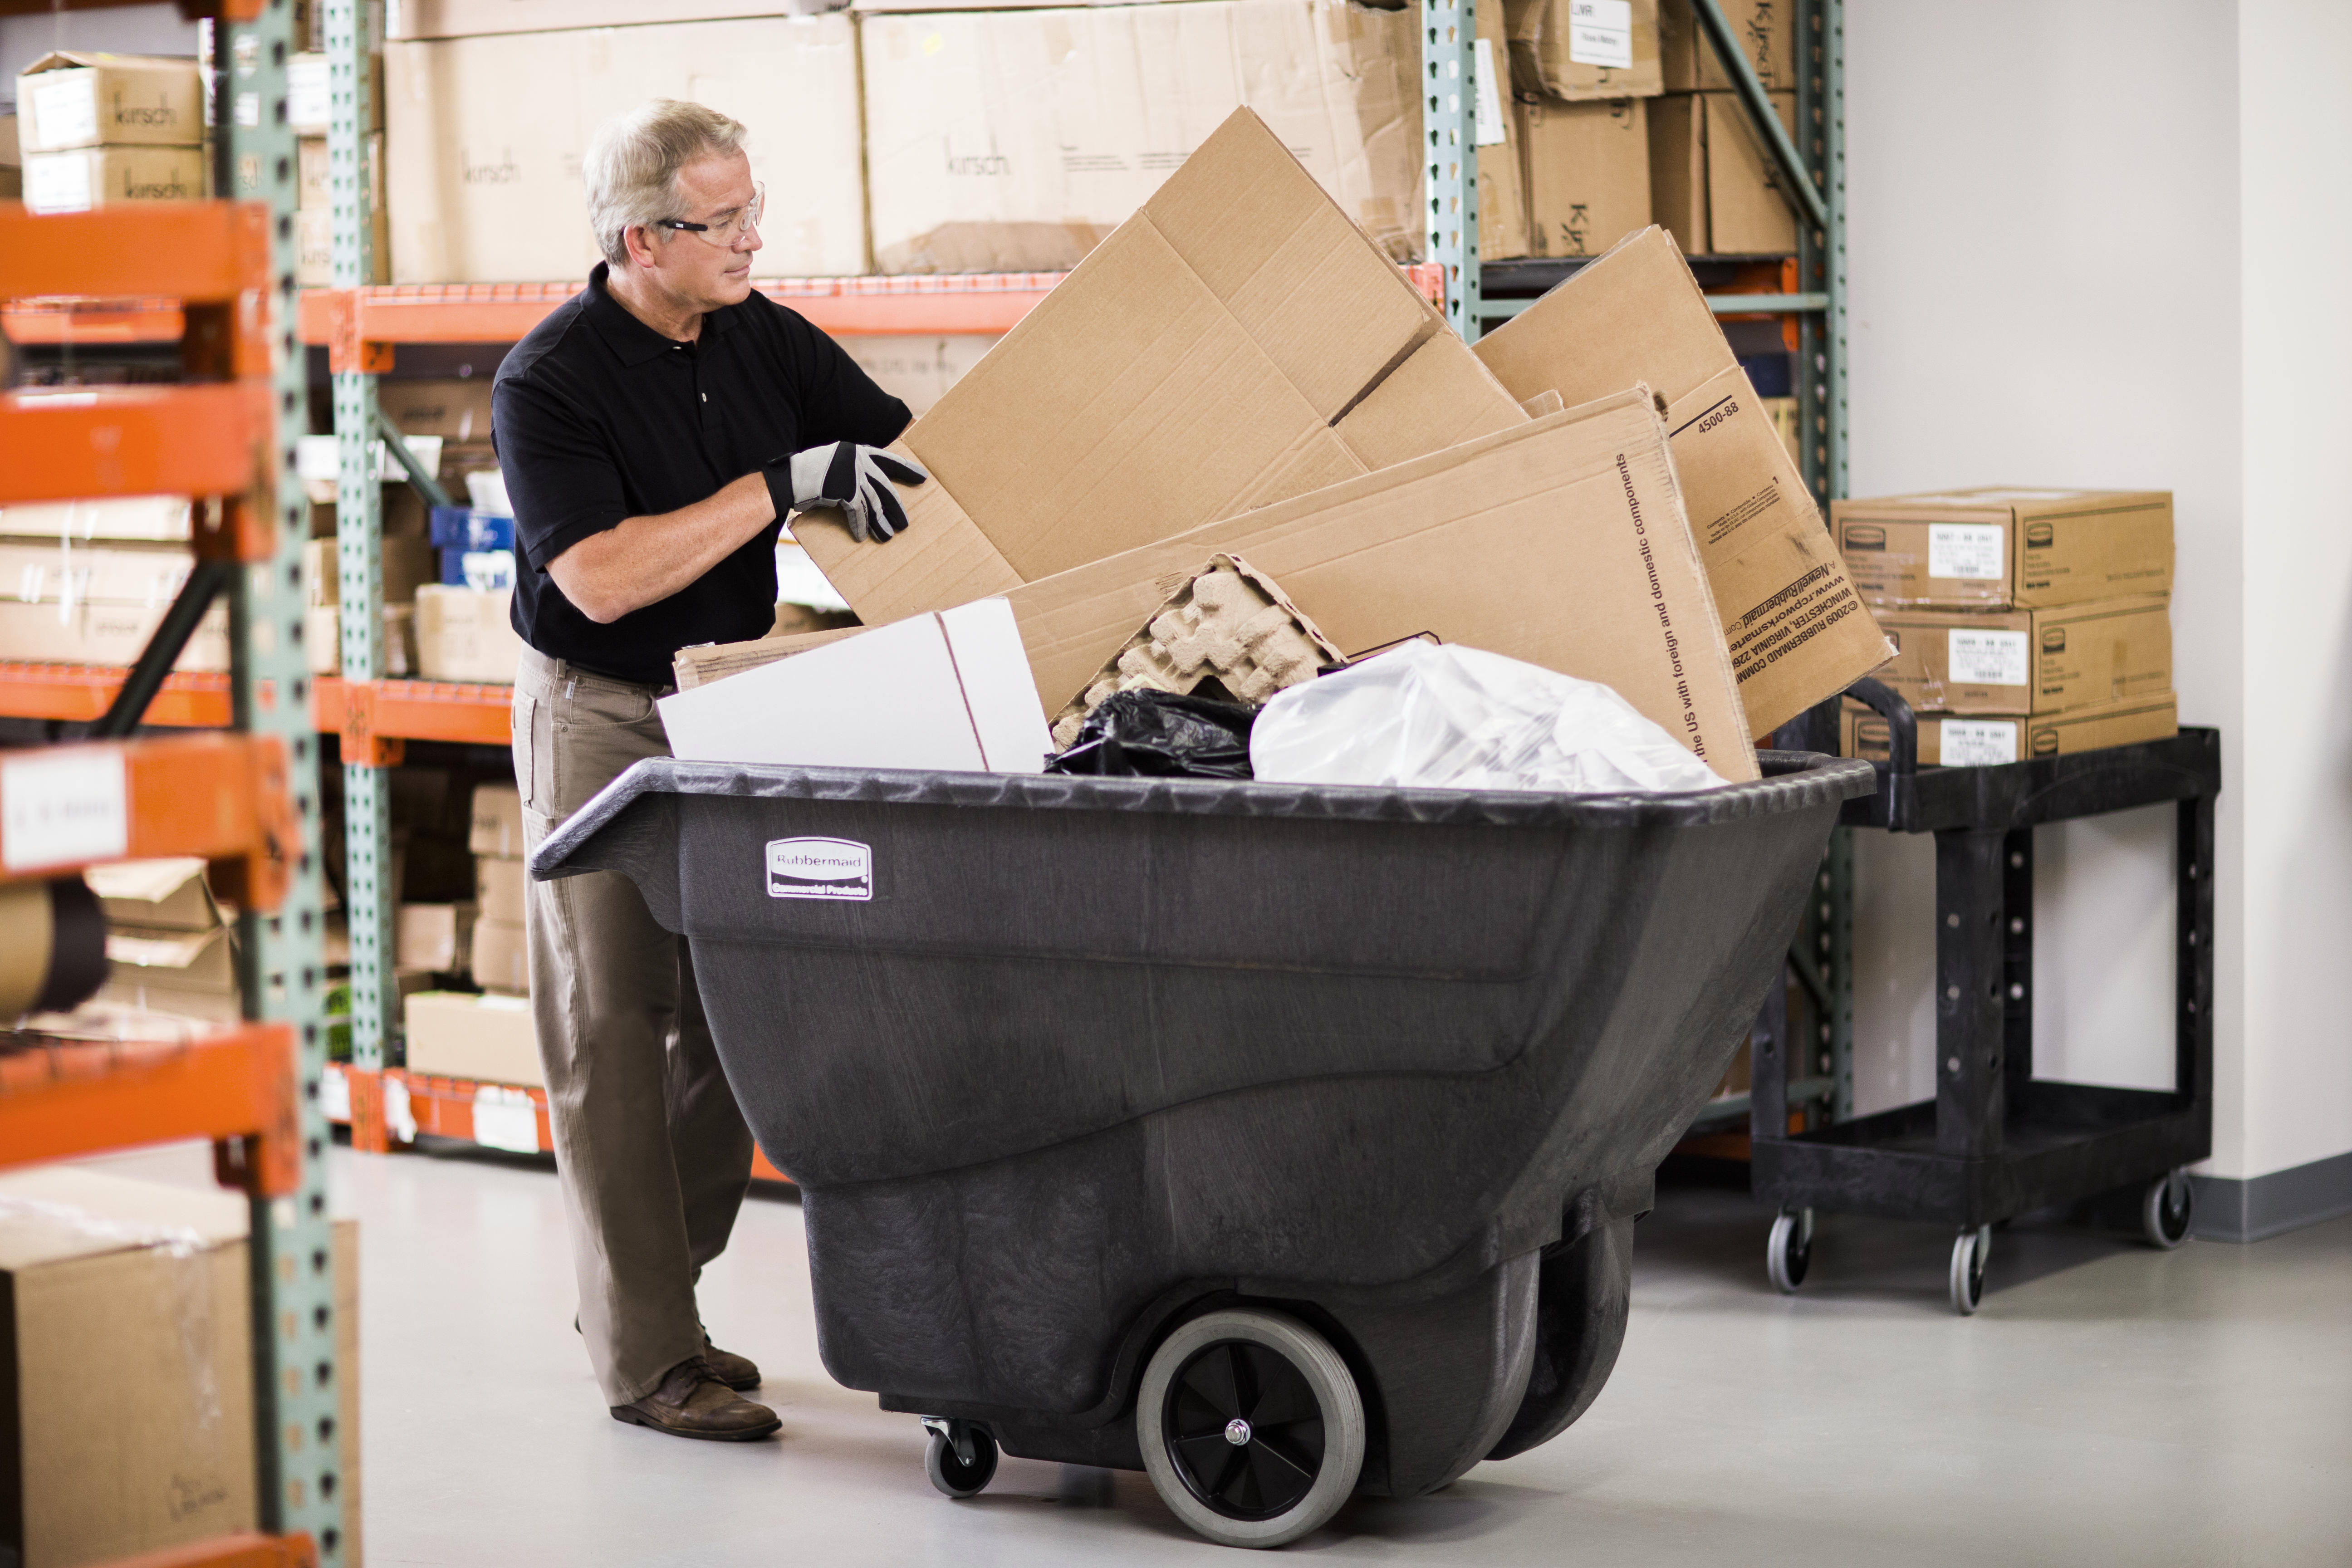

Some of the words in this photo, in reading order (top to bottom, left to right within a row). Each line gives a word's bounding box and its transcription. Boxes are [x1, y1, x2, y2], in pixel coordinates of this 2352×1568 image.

[1699, 402, 1739, 433] 4500-88
[1616, 453, 1645, 535] components
[1707, 516, 1725, 529] Contents
[1730, 500, 1751, 514] Contenido
[1756, 485, 1774, 497] Contenu
[1772, 476, 1779, 484] 1
[1638, 538, 1662, 600] domestic
[1828, 560, 1836, 569] A
[1654, 603, 1671, 627] and
[1789, 587, 1852, 629] WINCHESTER,
[1664, 630, 1684, 678] foreign
[1750, 626, 1792, 656] VIRGINIA
[1766, 619, 1827, 663] RUBBERMAID
[1736, 658, 1767, 685] COMM
[1676, 680, 1692, 709] with
[1684, 711, 1698, 733] US
[1693, 735, 1705, 757] the
[777, 854, 861, 867] Rubbermaid
